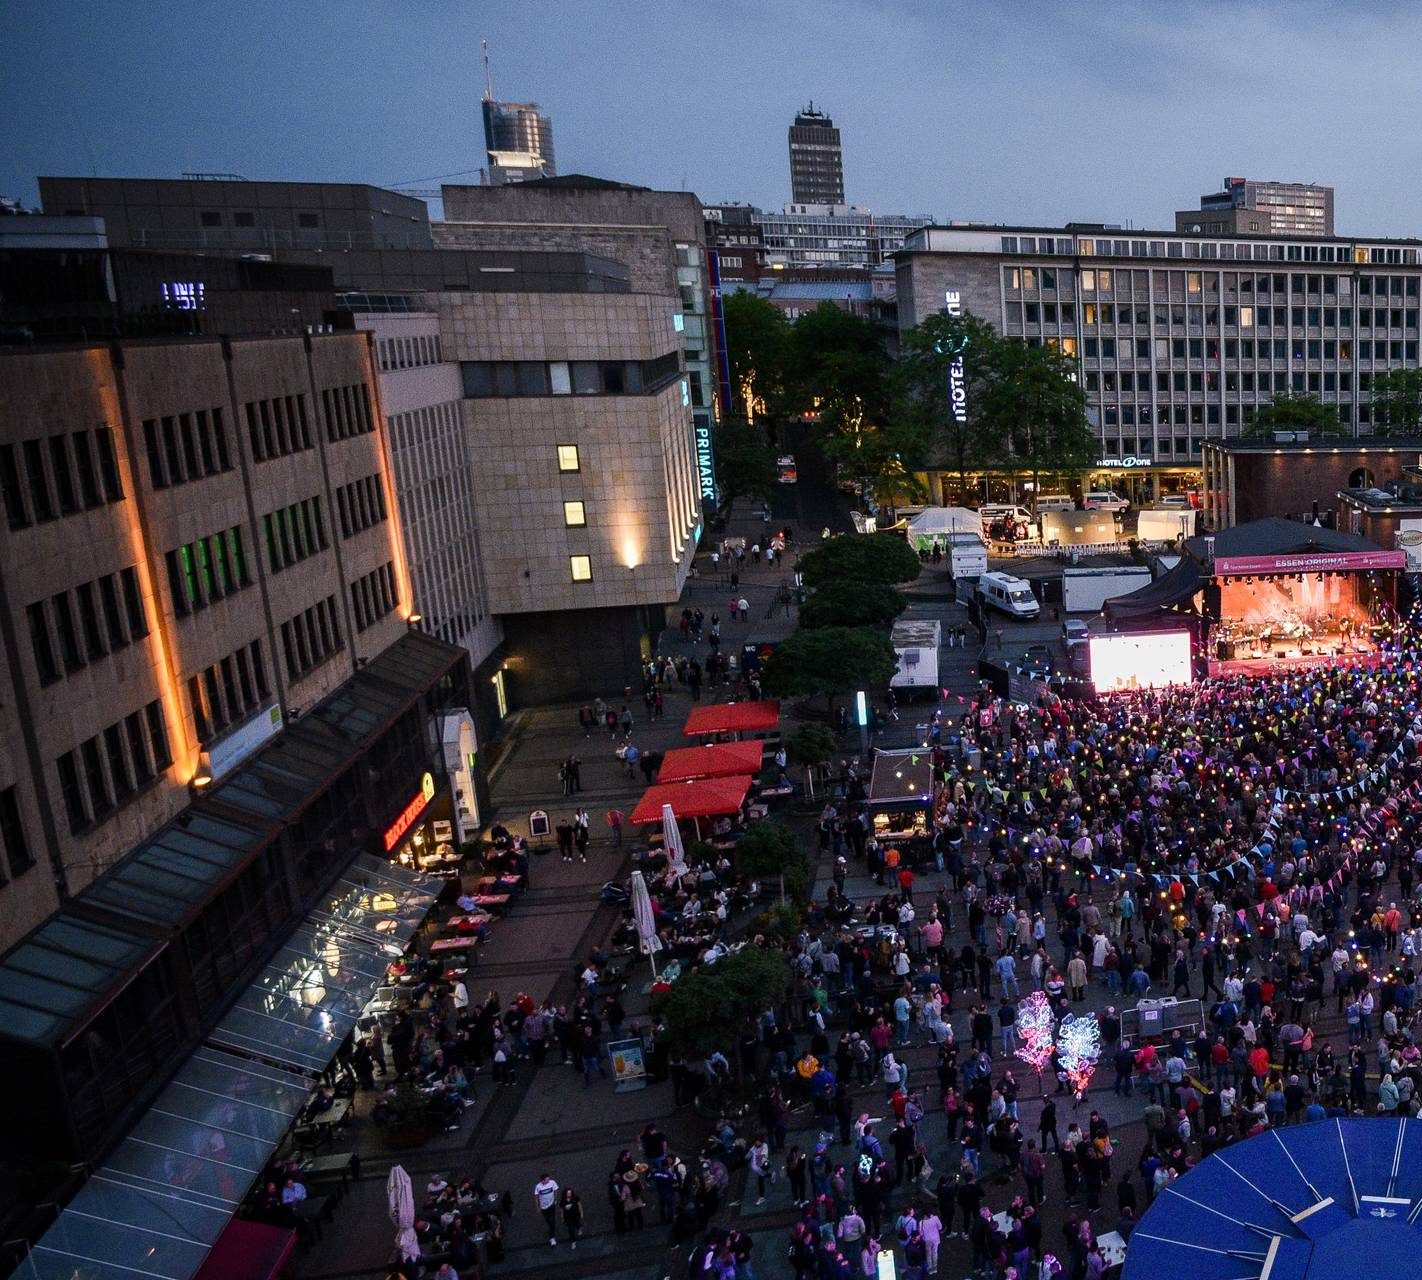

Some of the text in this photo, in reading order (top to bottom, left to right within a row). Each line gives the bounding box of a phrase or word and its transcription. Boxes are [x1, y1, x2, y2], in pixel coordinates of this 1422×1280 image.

[696, 428, 714, 498] PRIMARK
[1275, 557, 1348, 568] ESSEN ORIGINAL
[384, 814, 408, 851] BLOCK
